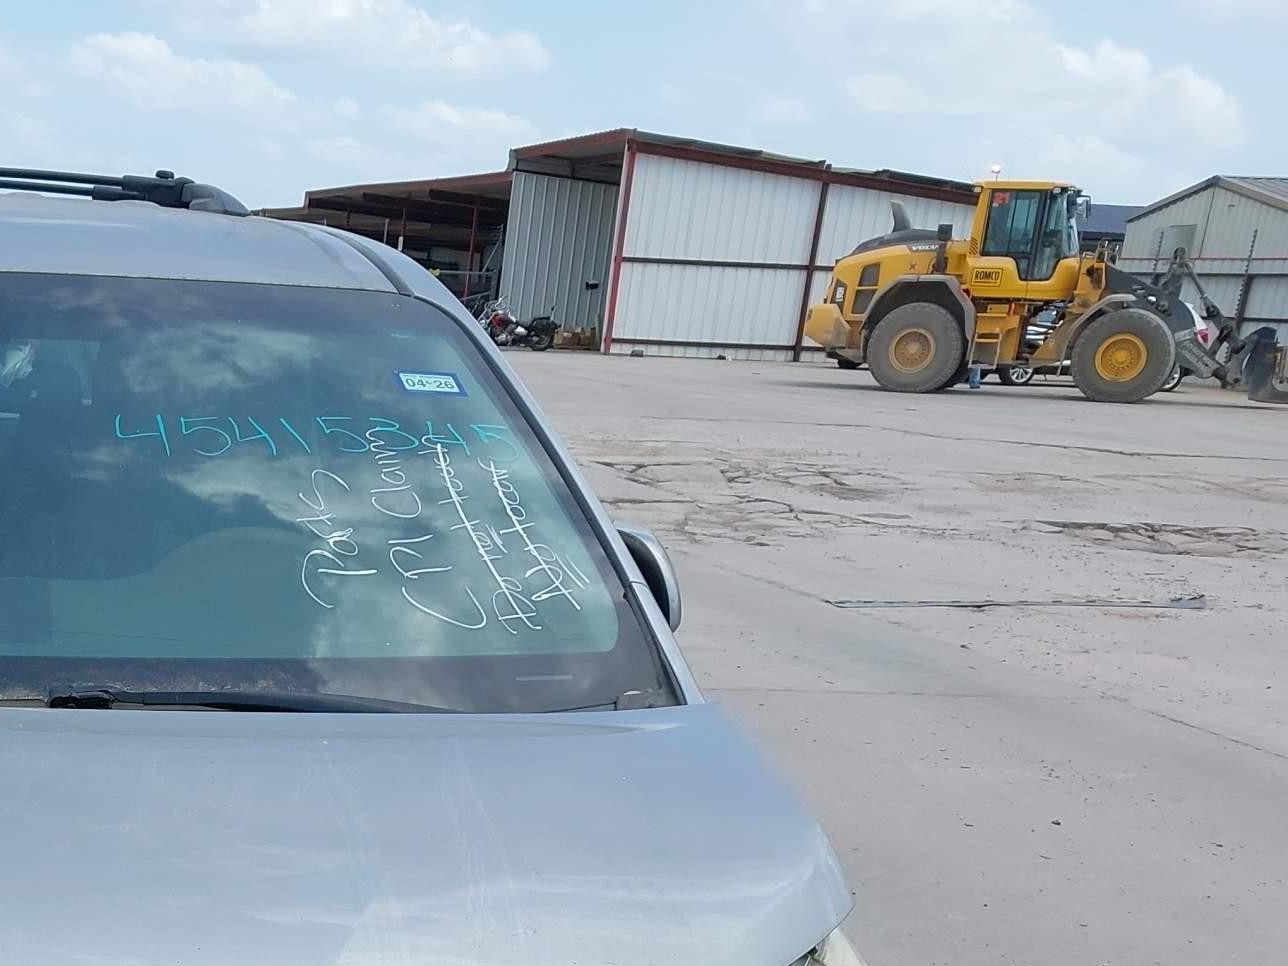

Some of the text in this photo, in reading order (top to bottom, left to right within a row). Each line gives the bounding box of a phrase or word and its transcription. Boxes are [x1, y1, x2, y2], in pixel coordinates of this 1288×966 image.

[974, 270, 1001, 281] ROMCO
[405, 378, 454, 389] 04 26
[115, 413, 519, 463] 45415345
